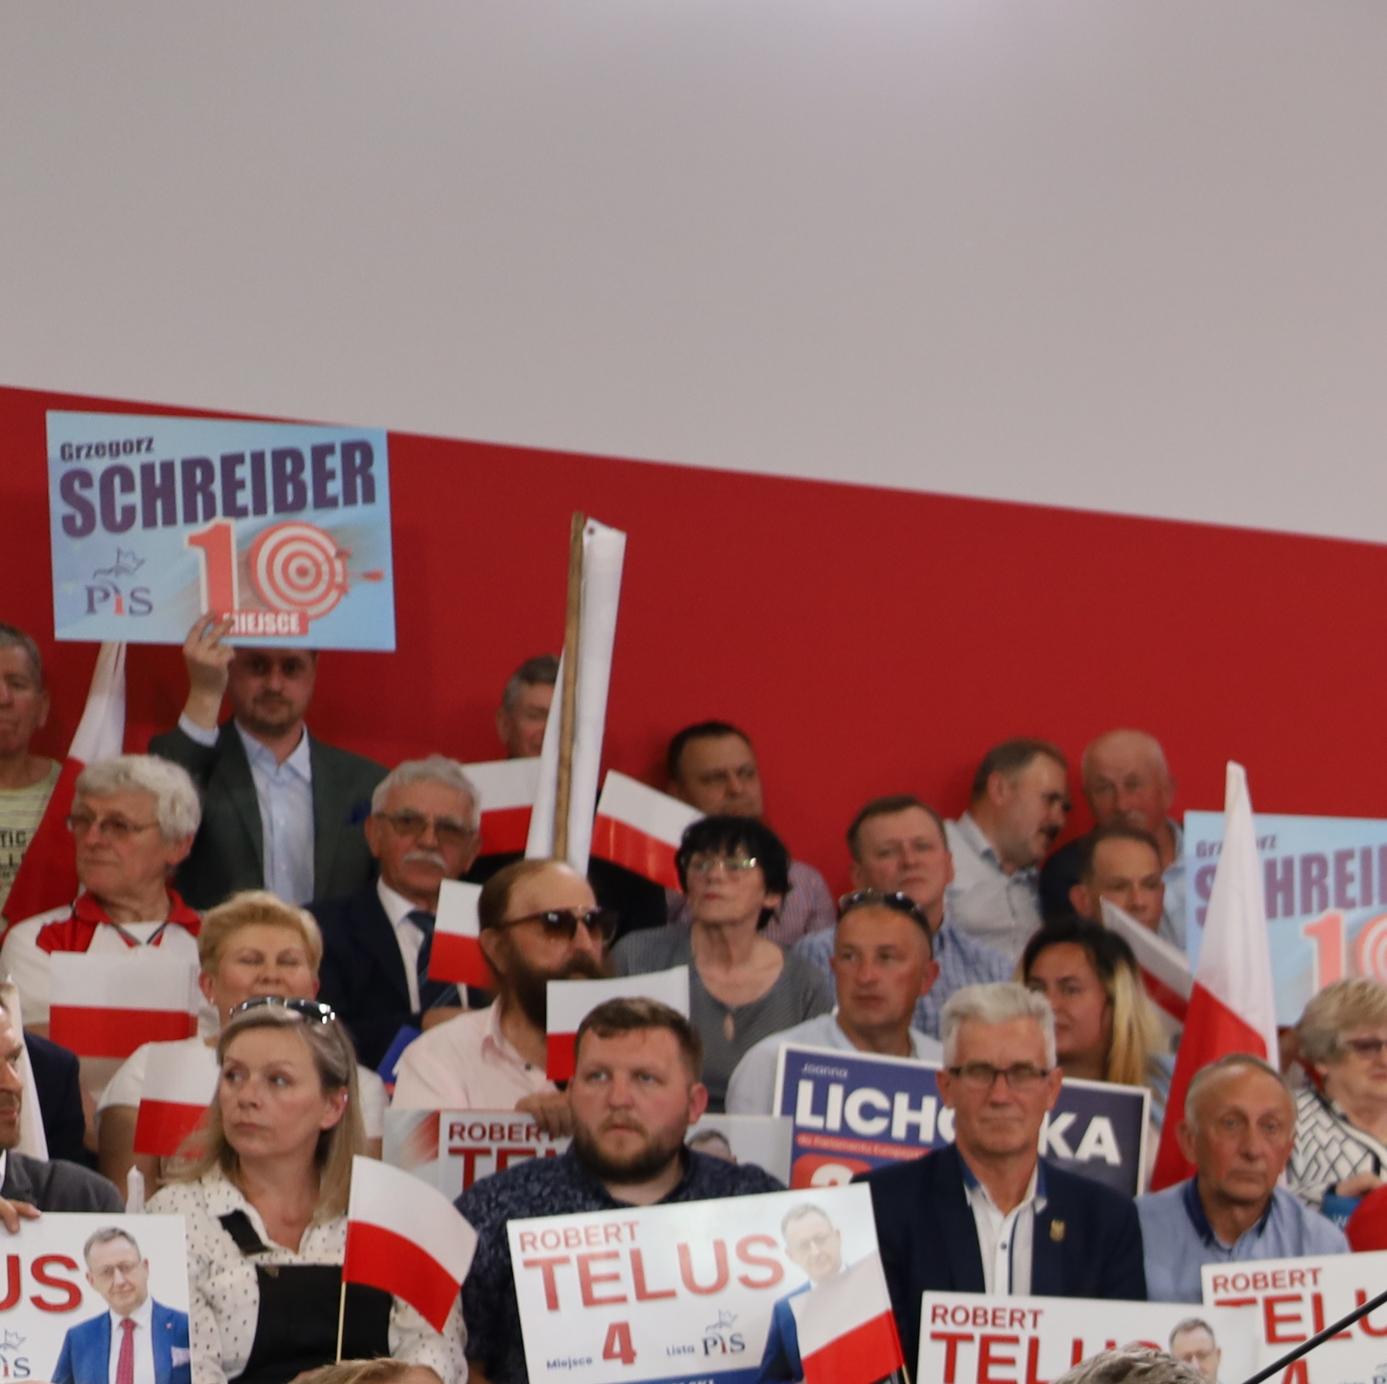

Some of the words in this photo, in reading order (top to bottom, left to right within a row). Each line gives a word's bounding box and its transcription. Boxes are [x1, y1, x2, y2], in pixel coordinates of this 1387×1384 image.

[60, 436, 154, 462] Grzegorz
[59, 440, 377, 539] SCHREIBER
[803, 1062, 849, 1080] Joanna
[518, 1220, 640, 1252] ROBERT
[522, 1234, 785, 1312] TELUS
[1212, 1267, 1323, 1294] ROBERT
[930, 1304, 1043, 1329] ROBERT
[546, 1355, 593, 1371] Miejsce
[602, 1320, 637, 1365] 4
[666, 1344, 695, 1357] Lista
